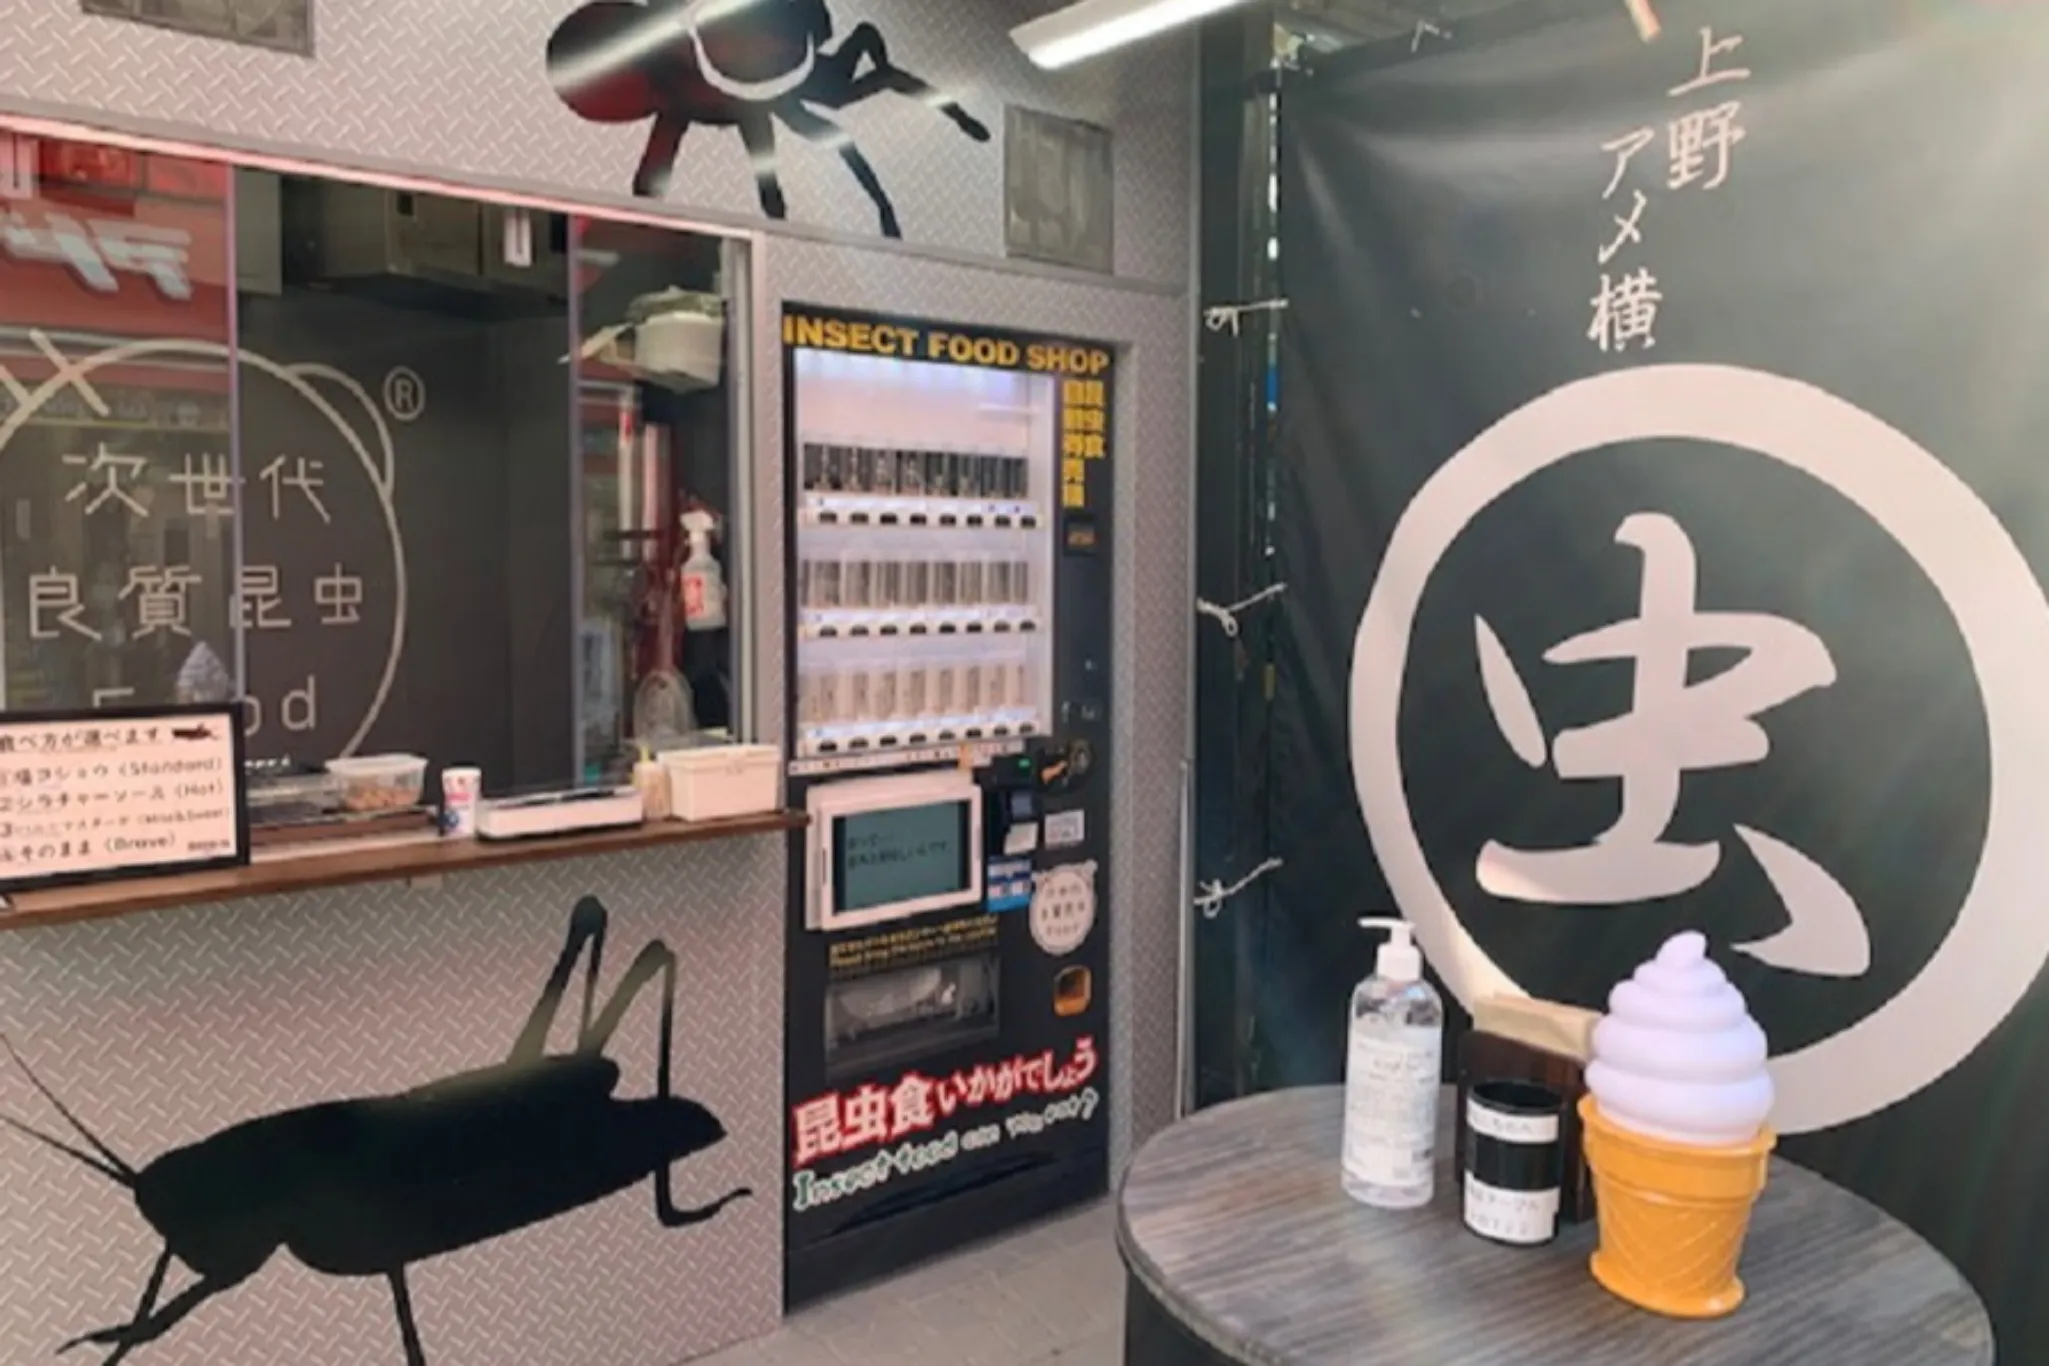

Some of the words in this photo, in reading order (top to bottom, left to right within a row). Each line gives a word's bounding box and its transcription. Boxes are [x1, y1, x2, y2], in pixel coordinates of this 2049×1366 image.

[1667, 26, 1751, 190] 上野
[1586, 127, 1663, 352] アメ横
[782, 313, 919, 355] INSECT
[928, 331, 1020, 367] FOOD
[1026, 343, 1110, 376] SHOP
[61, 442, 331, 525] 次世代
[28, 562, 364, 641] 良質昆虫
[1475, 511, 1871, 977] 虫
[793, 1035, 1099, 1166] 昆虫食いかがでしょう
